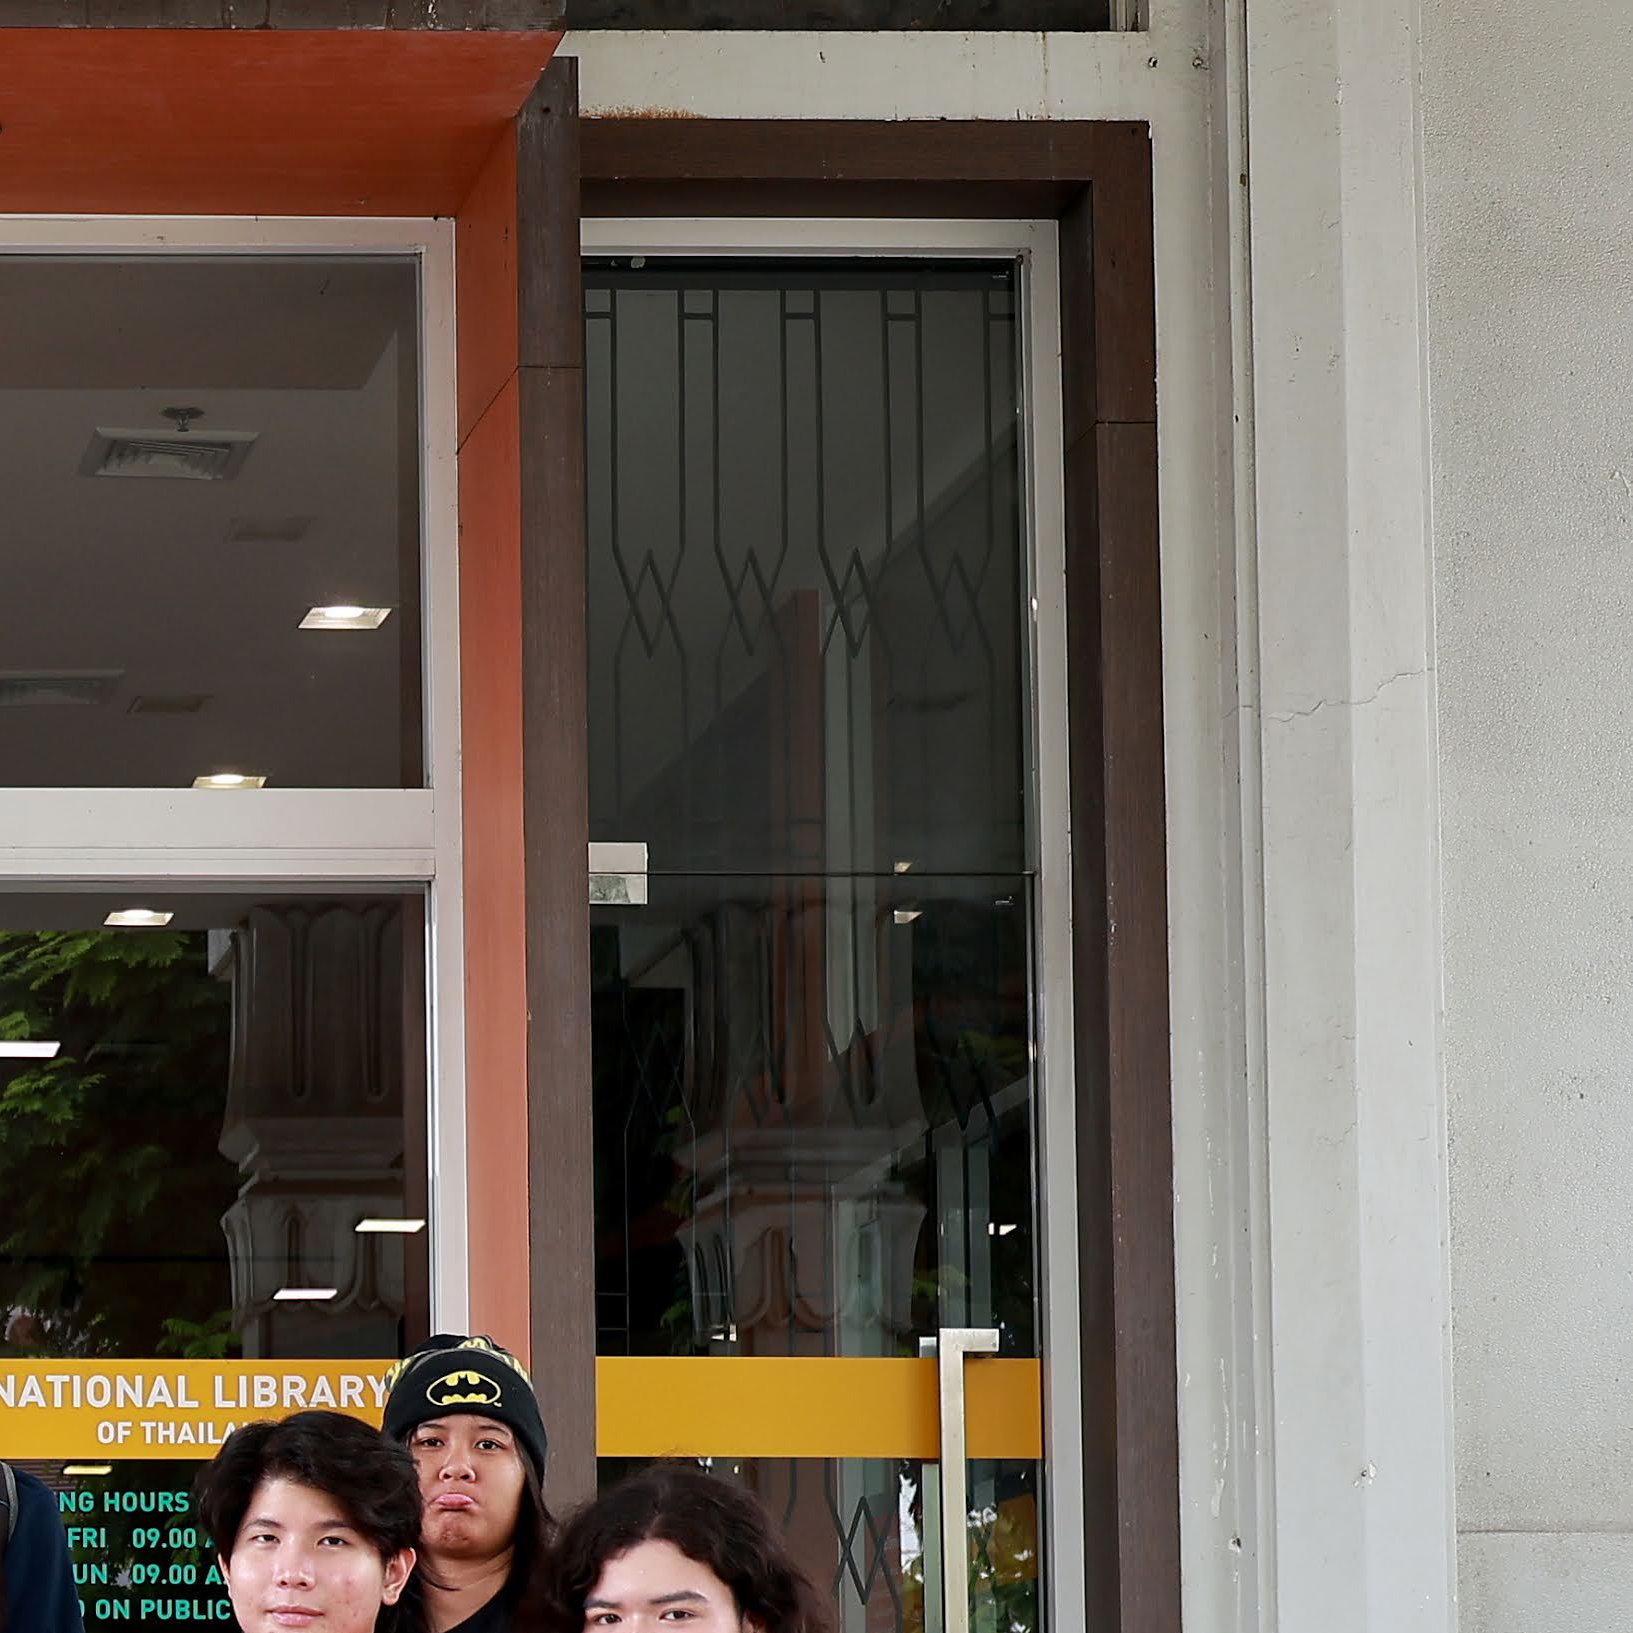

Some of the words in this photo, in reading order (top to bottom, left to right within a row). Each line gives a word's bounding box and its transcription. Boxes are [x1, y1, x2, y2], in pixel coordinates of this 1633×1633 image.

[214, 1374, 387, 1408] LIBRARY
[97, 1421, 133, 1444] OF
[140, 1421, 247, 1444] THAILA
[54, 1491, 95, 1513] NG
[103, 1491, 190, 1513] HOURS
[67, 1528, 106, 1548] FRI
[132, 1528, 197, 1548] 09.00
[72, 1564, 108, 1585] UN
[132, 1564, 197, 1585] 09.00
[95, 1599, 130, 1620] ON
[140, 1599, 231, 1620] PUBLIC
